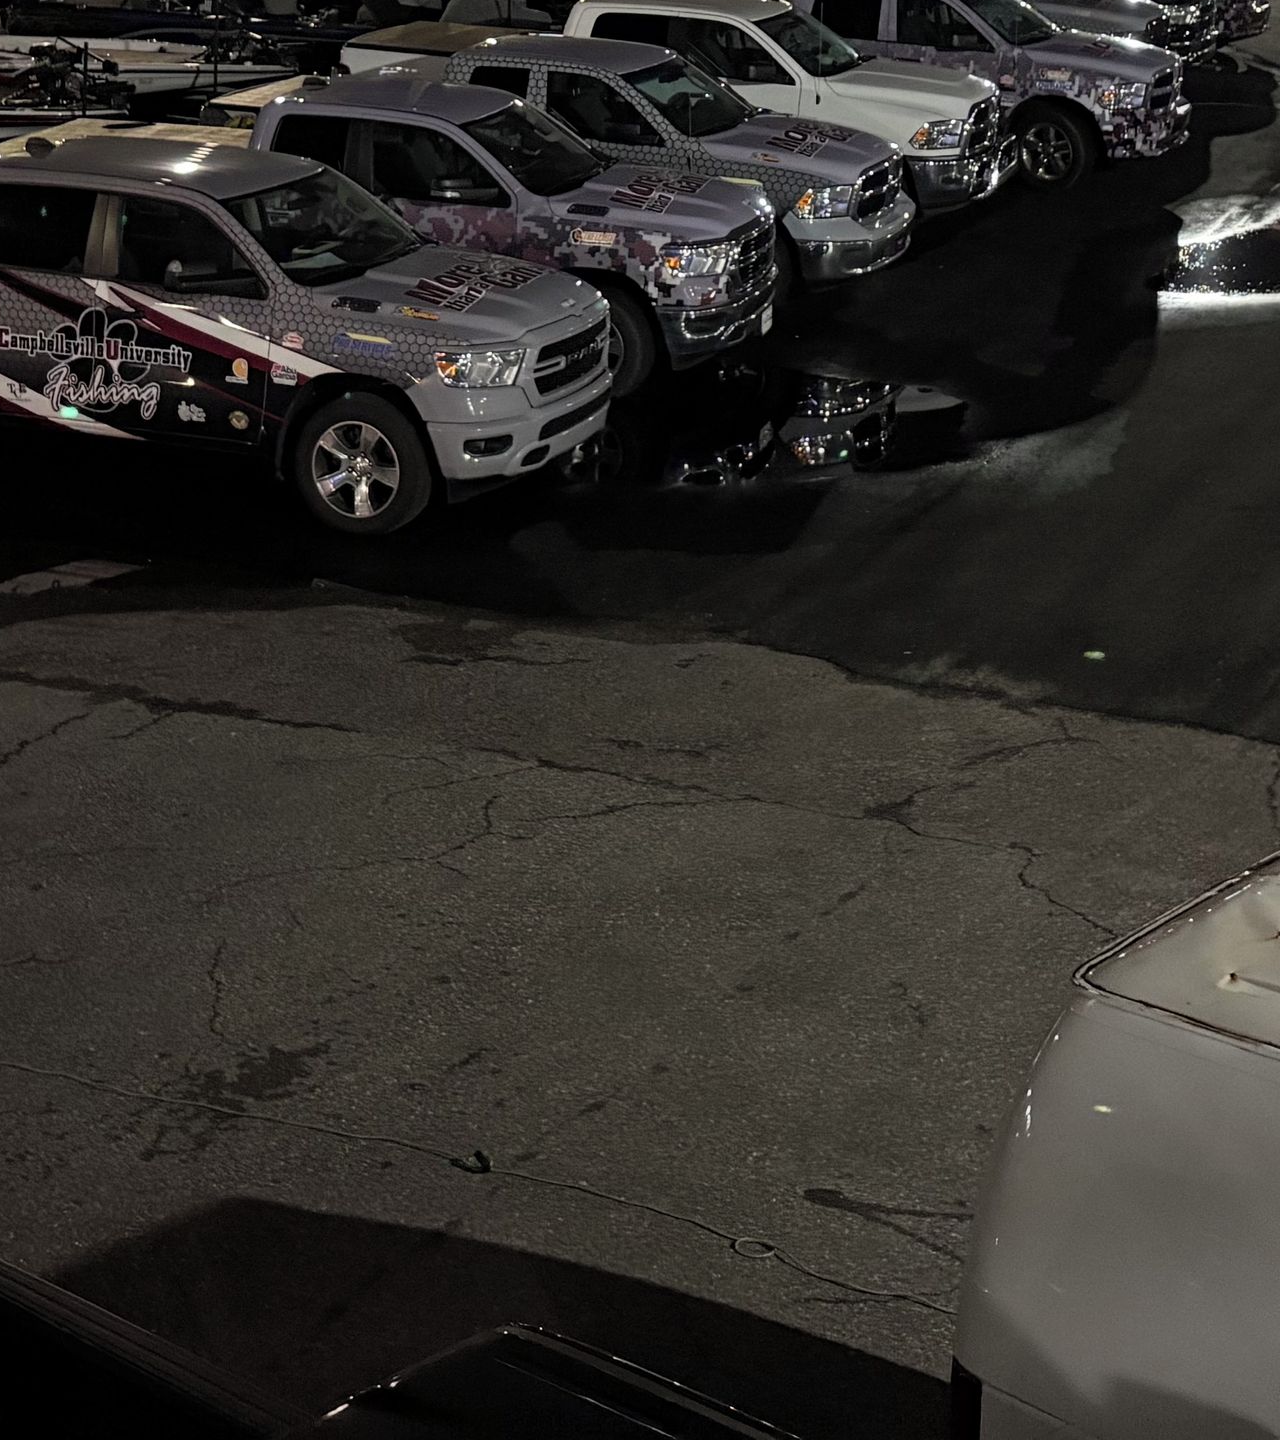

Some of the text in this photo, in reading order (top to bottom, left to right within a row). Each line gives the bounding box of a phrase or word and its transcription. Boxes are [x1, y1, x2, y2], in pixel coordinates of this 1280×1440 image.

[404, 263, 485, 306] More
[443, 287, 483, 312] than
[106, 336, 192, 373] University
[44, 364, 161, 419] Fishing
